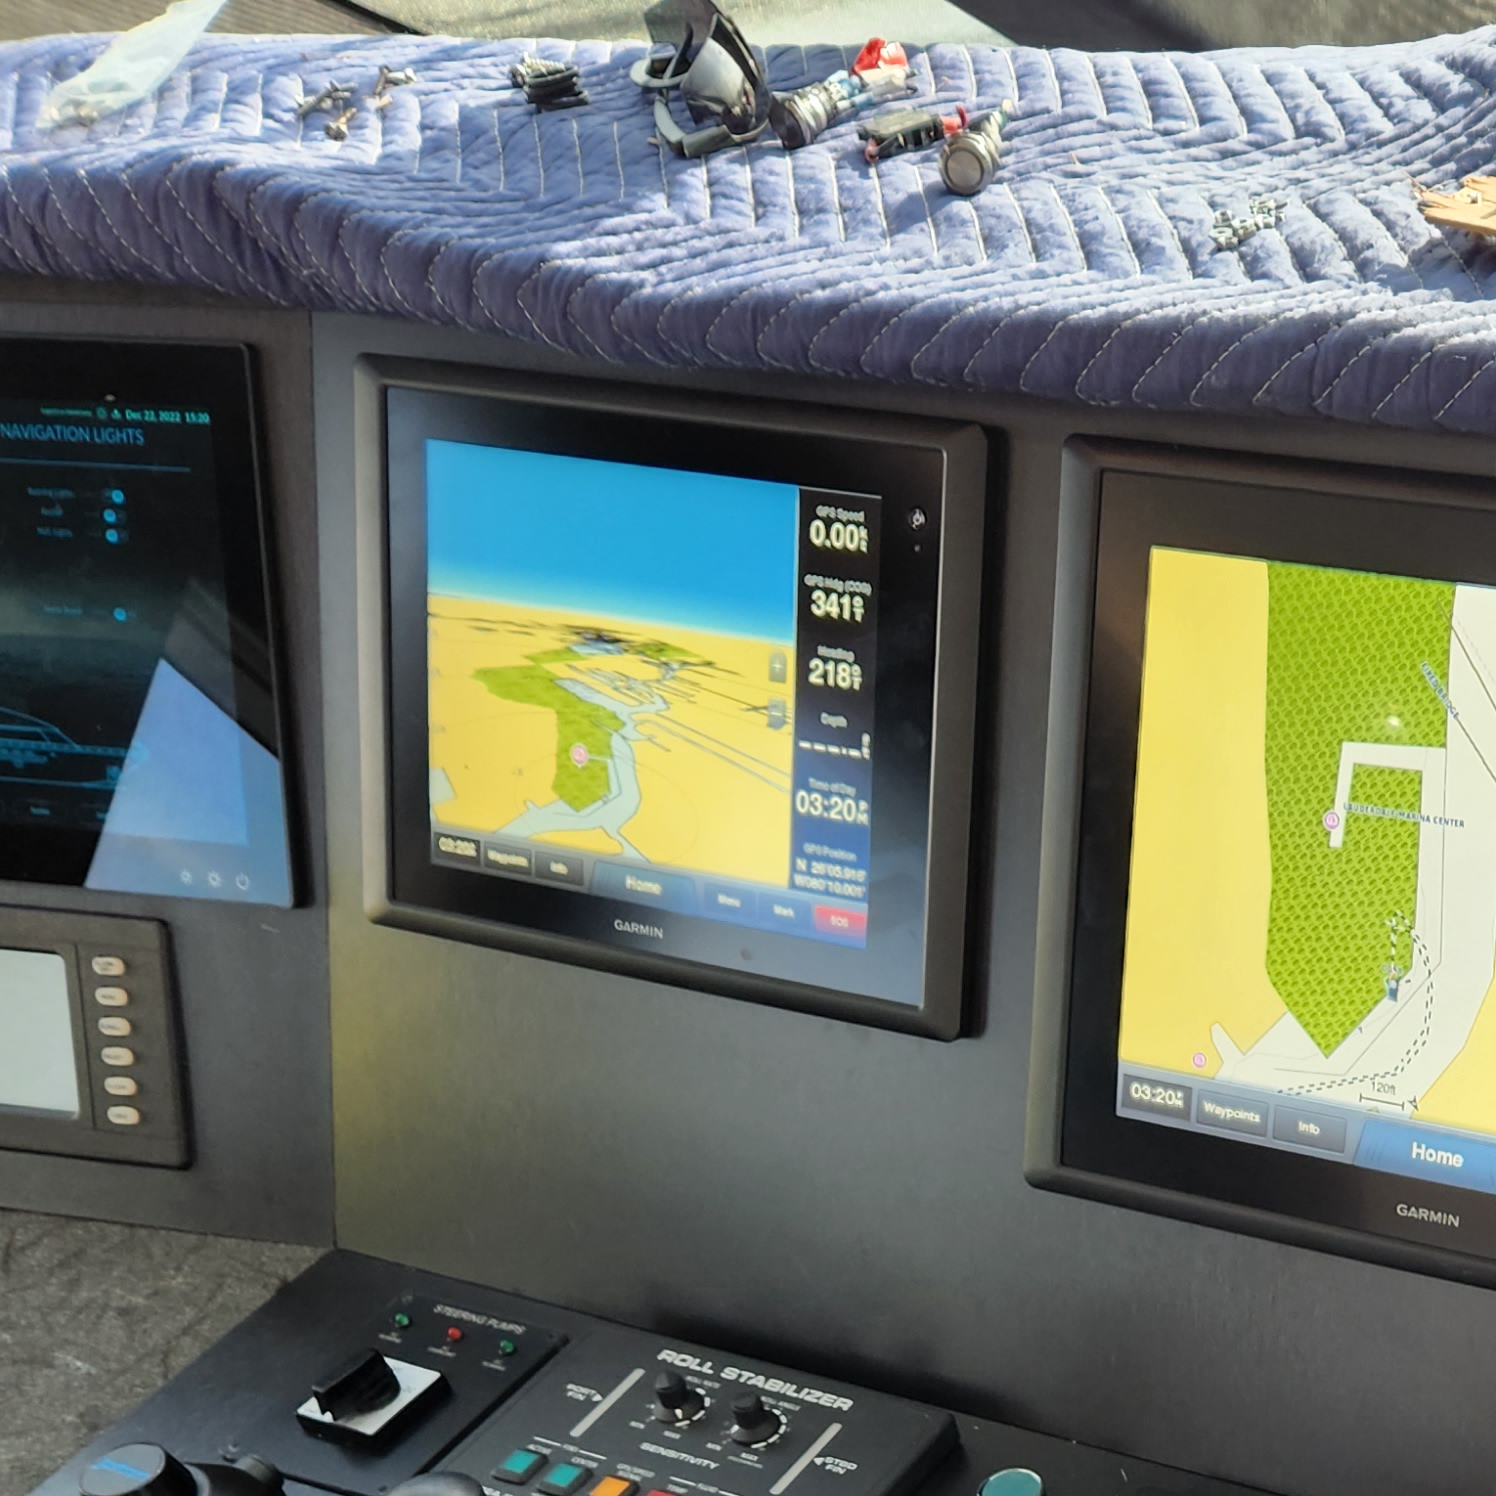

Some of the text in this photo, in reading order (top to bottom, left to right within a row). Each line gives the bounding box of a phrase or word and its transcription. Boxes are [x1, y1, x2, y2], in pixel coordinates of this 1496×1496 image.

[1, 423, 145, 445] NAVIGATION LIGHTS
[796, 791, 856, 821] 03:20
[1433, 816, 1465, 829] CENTER
[625, 875, 662, 895] Home
[614, 919, 664, 939] GARMIN
[1203, 1100, 1261, 1123] Waypoints
[1298, 1120, 1320, 1135] Info
[1411, 1142, 1464, 1168] Home
[1396, 1203, 1460, 1227] GARMIN
[433, 1304, 487, 1325] STEERING
[656, 1349, 854, 1411] ROLL STABILIZER
[640, 1442, 719, 1470] SENSITIVITY
